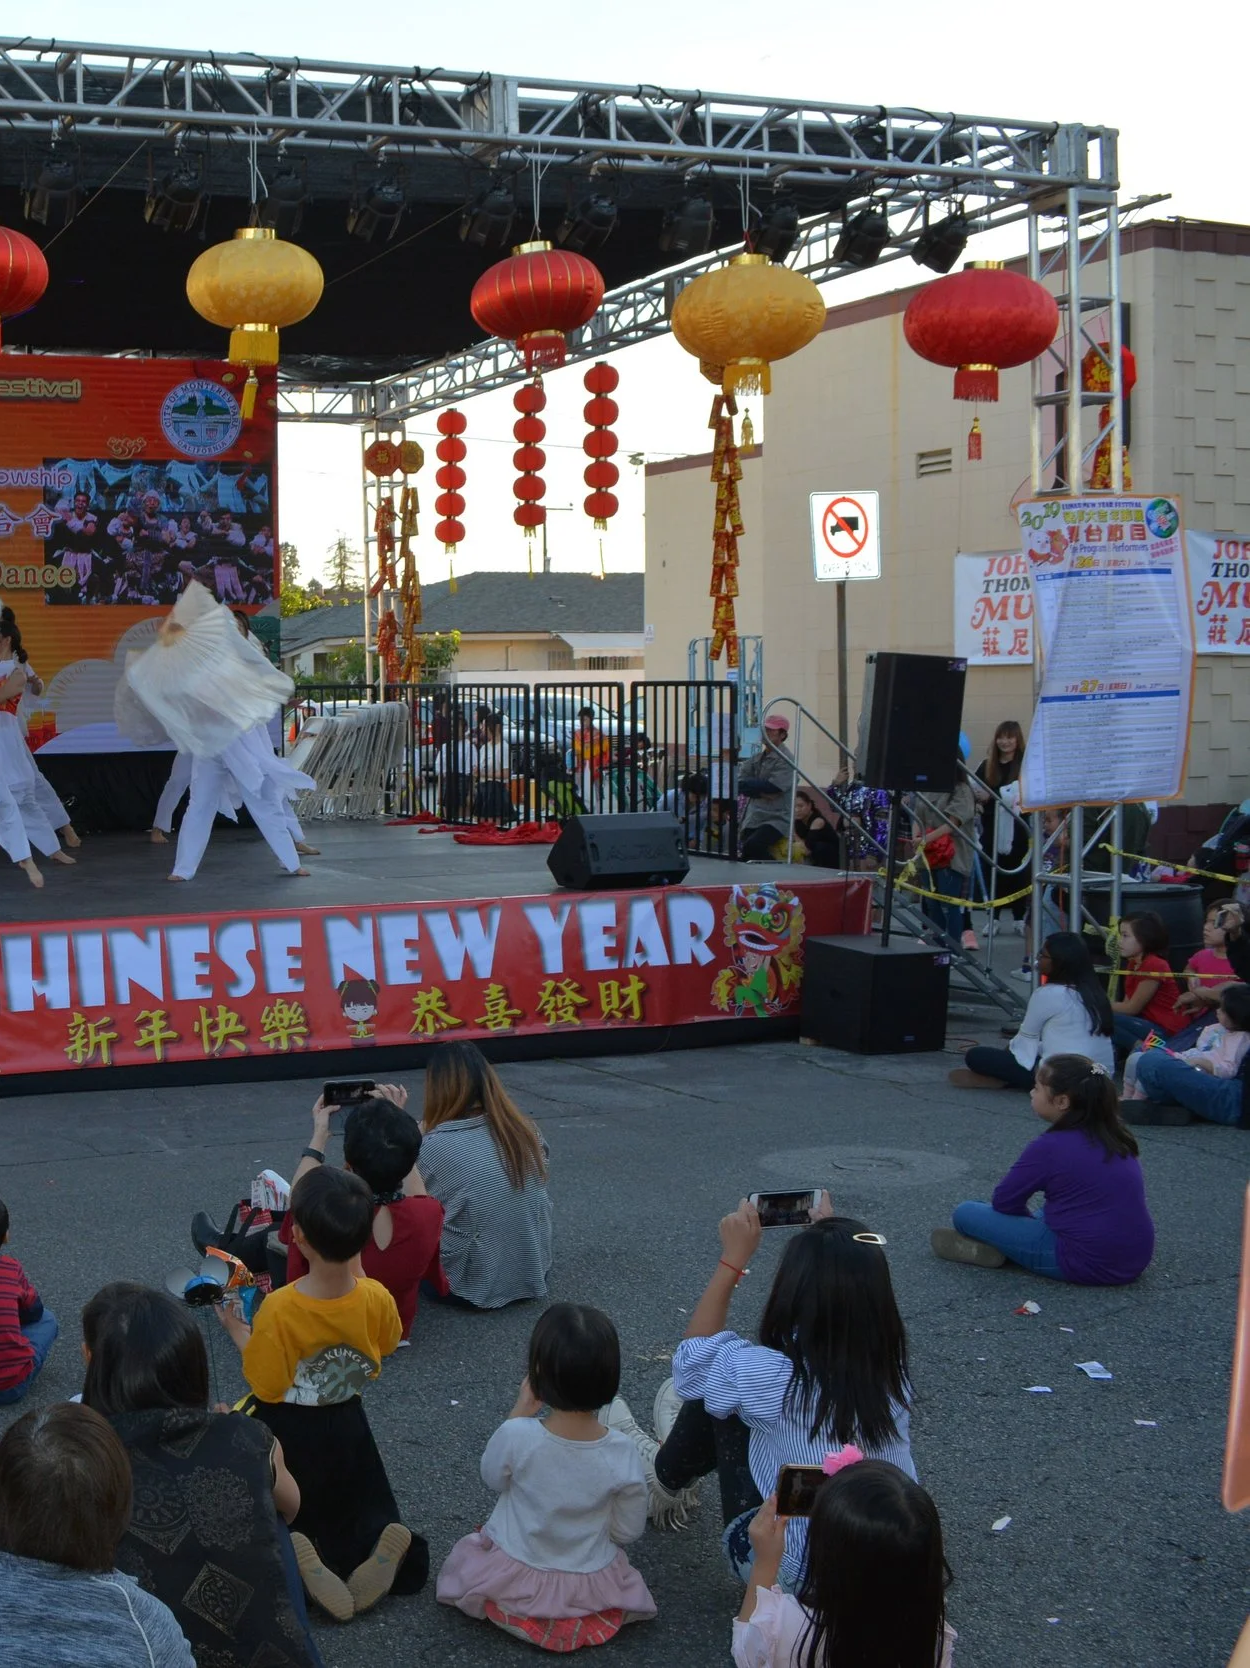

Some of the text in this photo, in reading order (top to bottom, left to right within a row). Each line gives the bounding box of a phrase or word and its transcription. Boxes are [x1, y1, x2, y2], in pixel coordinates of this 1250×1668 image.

[163, 405, 171, 428] CITY
[181, 382, 233, 404] MONTEREY
[177, 440, 227, 454] CALIFORNIA
[1020, 501, 1061, 530] 2019
[324, 908, 501, 989] NEW
[523, 894, 717, 975] YEAR
[64, 974, 648, 1065] 新年快樂 恭喜發財
[324, 1348, 362, 1363] KUNG
